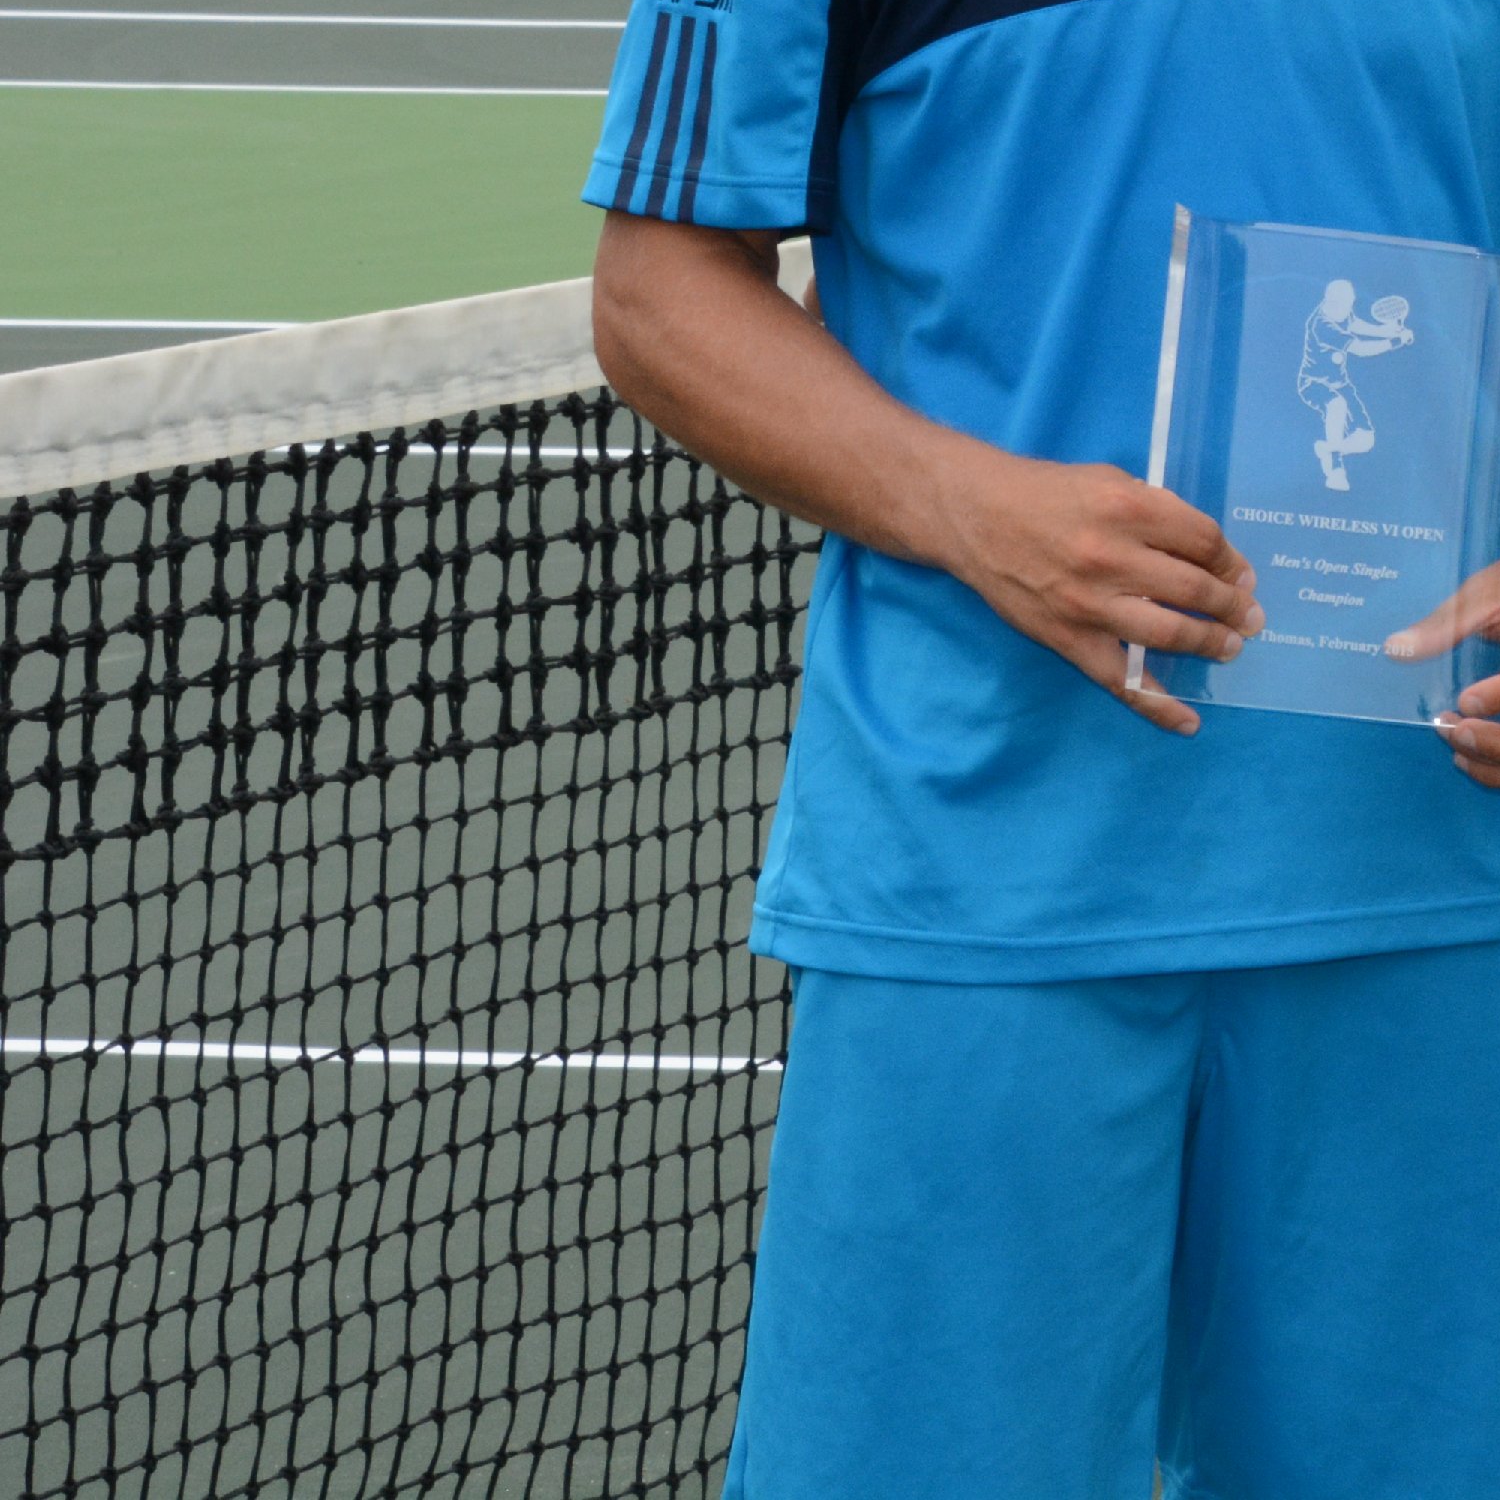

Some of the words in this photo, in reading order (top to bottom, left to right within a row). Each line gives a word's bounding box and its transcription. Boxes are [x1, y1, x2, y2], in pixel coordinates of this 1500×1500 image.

[1232, 506, 1295, 526] CHOICE
[1299, 513, 1378, 536] WIRELESS
[1382, 522, 1399, 537] VI
[1402, 525, 1445, 542] OPEN
[1271, 553, 1311, 569] Men's
[1314, 558, 1349, 575] Open
[1350, 561, 1399, 580] Singles
[1298, 588, 1365, 607] Champion
[1260, 628, 1315, 648] Thomas,
[1319, 635, 1381, 656] February
[1384, 643, 1415, 657] 2015
